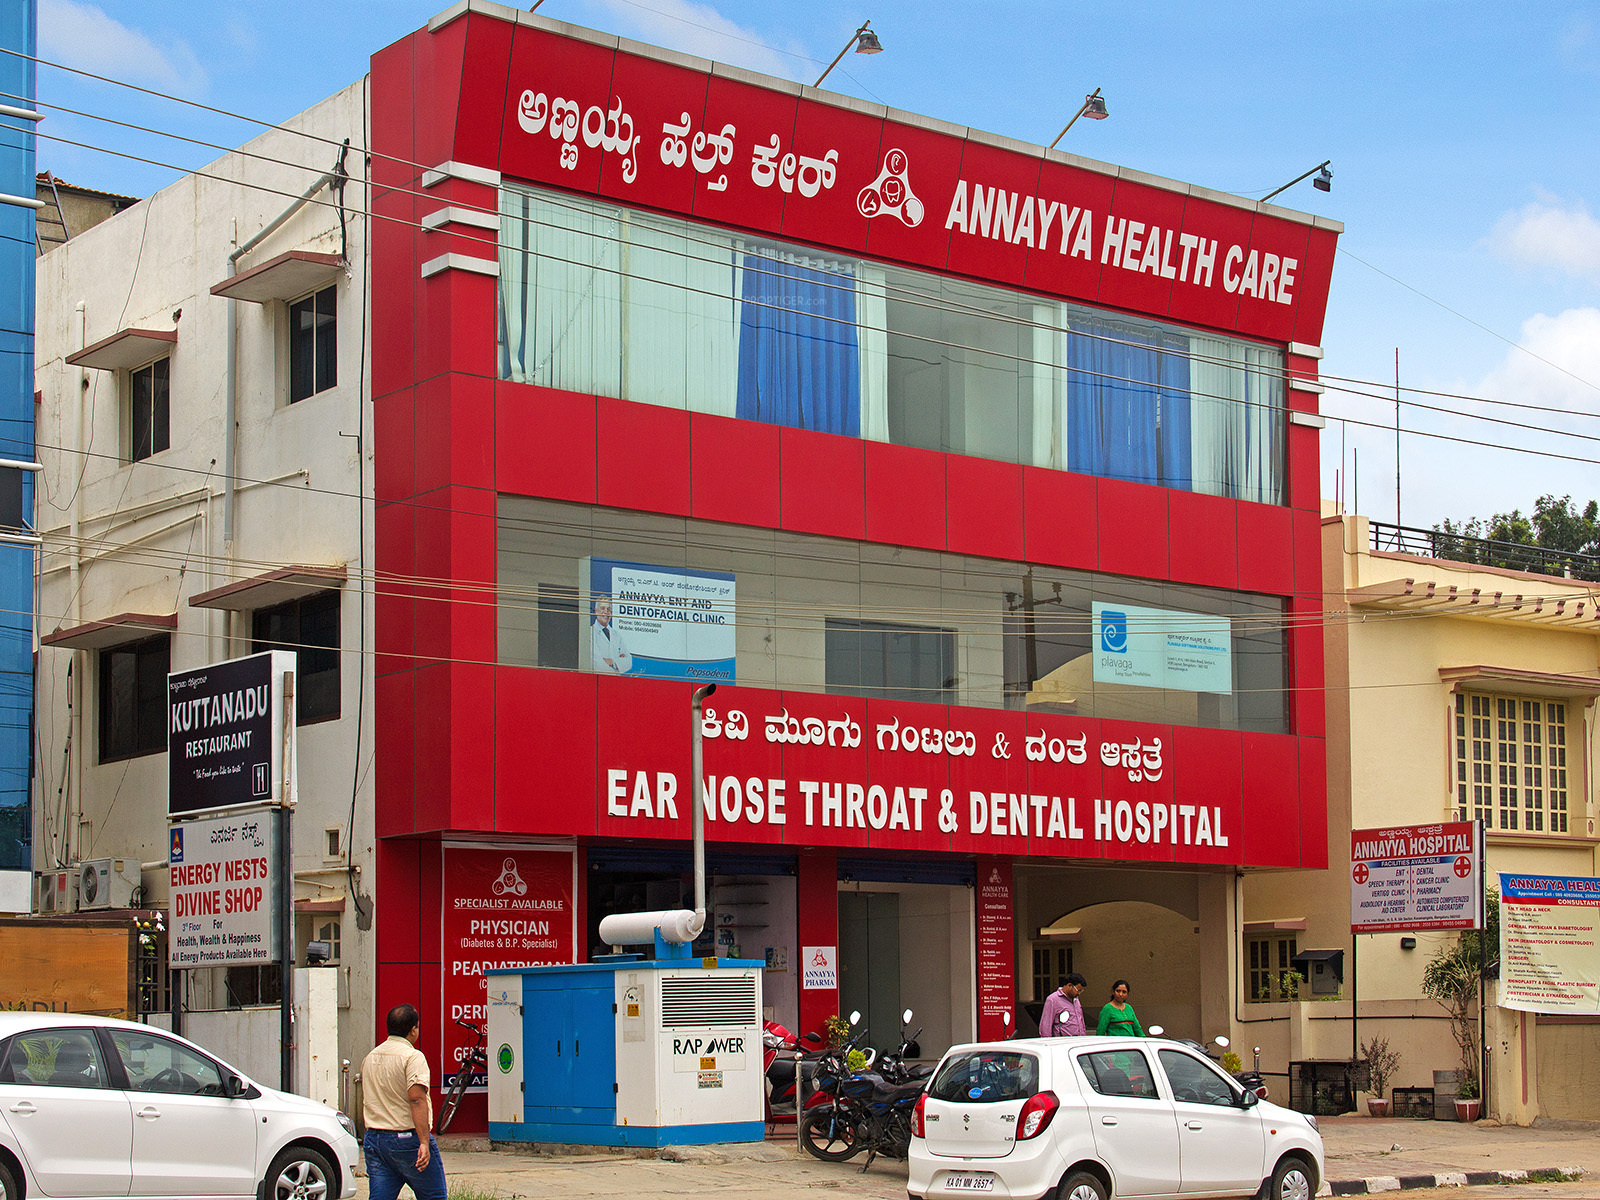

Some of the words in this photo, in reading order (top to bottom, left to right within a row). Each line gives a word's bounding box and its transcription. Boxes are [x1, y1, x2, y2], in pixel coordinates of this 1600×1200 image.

[517, 89, 641, 184] ಅಣ್ಣಯ್ಯ
[751, 133, 839, 198] ಕೇರ್
[944, 179, 1092, 261] ANNAYYA
[1100, 214, 1218, 288] HEALTH
[1223, 244, 1298, 305] CARE
[619, 590, 666, 605] ANNAYYA
[669, 596, 688, 607] ENT
[691, 599, 712, 610] AND
[619, 605, 690, 621] DENTOFACIAL
[692, 613, 725, 625] CLINIC
[1101, 655, 1132, 671] plavaga
[686, 666, 730, 678] Pepsodent
[172, 684, 268, 734] KUTTANADU
[701, 708, 749, 740] ಕಿವಿ
[765, 707, 861, 748] ಮೂಗು
[876, 716, 976, 757] ಗಂಟಲು
[991, 731, 1012, 760] &
[1025, 728, 1088, 764] ದಂತ
[186, 730, 252, 759] RESTAURANT
[607, 768, 679, 819] EAR
[702, 775, 787, 825] NOSE
[799, 780, 928, 832] THROAT
[937, 788, 959, 833] &
[969, 791, 1084, 840] DENTAL
[1094, 799, 1229, 847] HOSPITAL
[1354, 839, 1407, 859] ANNAYYA
[1410, 834, 1471, 855] HOSPITAL
[171, 862, 221, 887] ENERGY
[225, 857, 268, 882] NESTS
[1416, 867, 1434, 875] DENTAL
[1416, 877, 1434, 885] CANCER
[1434, 876, 1450, 884] CLINIC
[1509, 878, 1565, 890] ANNAYYA
[1567, 881, 1600, 892] HEAL
[1416, 887, 1442, 895] PHARMACY
[176, 890, 221, 917] DIVINE
[224, 886, 262, 914] SHOP
[454, 898, 509, 908] SPECIALIST
[511, 899, 563, 910] AVAILABLE
[1387, 899, 1405, 907] HEARING
[1416, 904, 1435, 912] CLINICAL
[1436, 903, 1464, 911] LABORATORY
[189, 922, 201, 931] Floor
[213, 919, 223, 929] For
[471, 920, 549, 935] PHYSICIAN
[177, 936, 198, 948] Health,
[200, 934, 220, 946] Wealth
[222, 934, 227, 944] &
[228, 933, 261, 946] Happiness
[460, 938, 494, 949] (Diabetes
[497, 938, 503, 948] &
[505, 939, 520, 948] B.P.
[521, 939, 558, 949] Specialist)
[180, 951, 199, 963] Energy
[200, 950, 224, 961] Products
[226, 949, 252, 960] Available
[253, 948, 267, 958] Here
[805, 979, 834, 987] PHARMA
[946, 1177, 954, 1187] KA
[955, 1177, 962, 1187] 01
[973, 1178, 989, 1189] 2657
